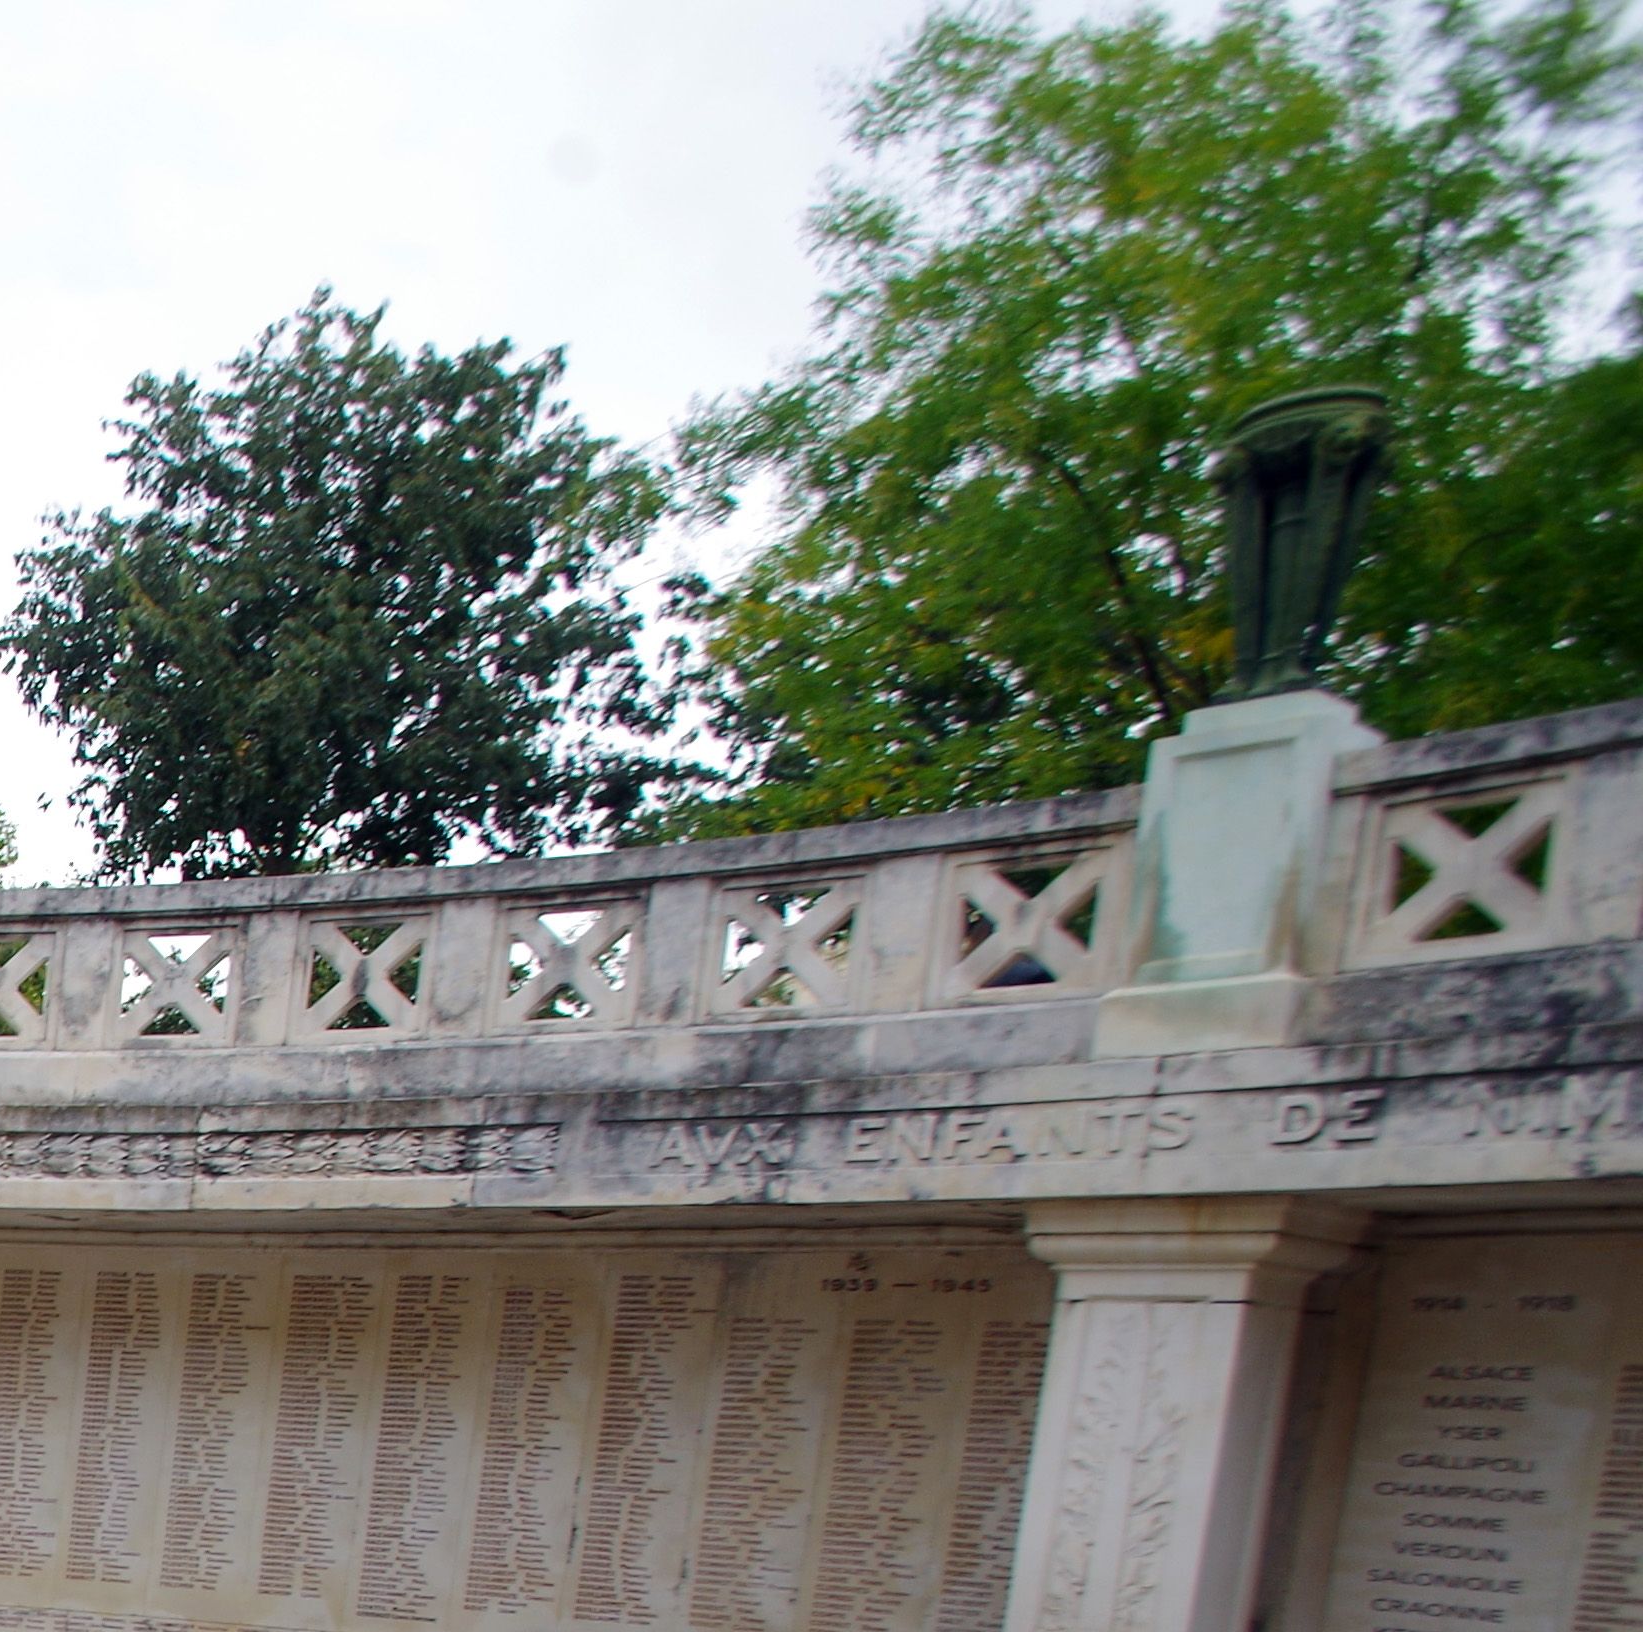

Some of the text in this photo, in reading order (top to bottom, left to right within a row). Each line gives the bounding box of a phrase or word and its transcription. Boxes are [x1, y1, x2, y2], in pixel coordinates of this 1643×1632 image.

[843, 1106, 1196, 1166] ENFANTS
[1270, 1087, 1387, 1147] DE
[1428, 1365, 1536, 1383] ALSACE
[1423, 1394, 1529, 1412] MARNE
[1373, 1481, 1549, 1505] CHAMPAGNE
[1402, 1512, 1507, 1533] SOMME
[1392, 1541, 1509, 1562] VERDUN
[1366, 1567, 1524, 1595] SALONIQUE
[1370, 1596, 1506, 1624] CRAONNE
